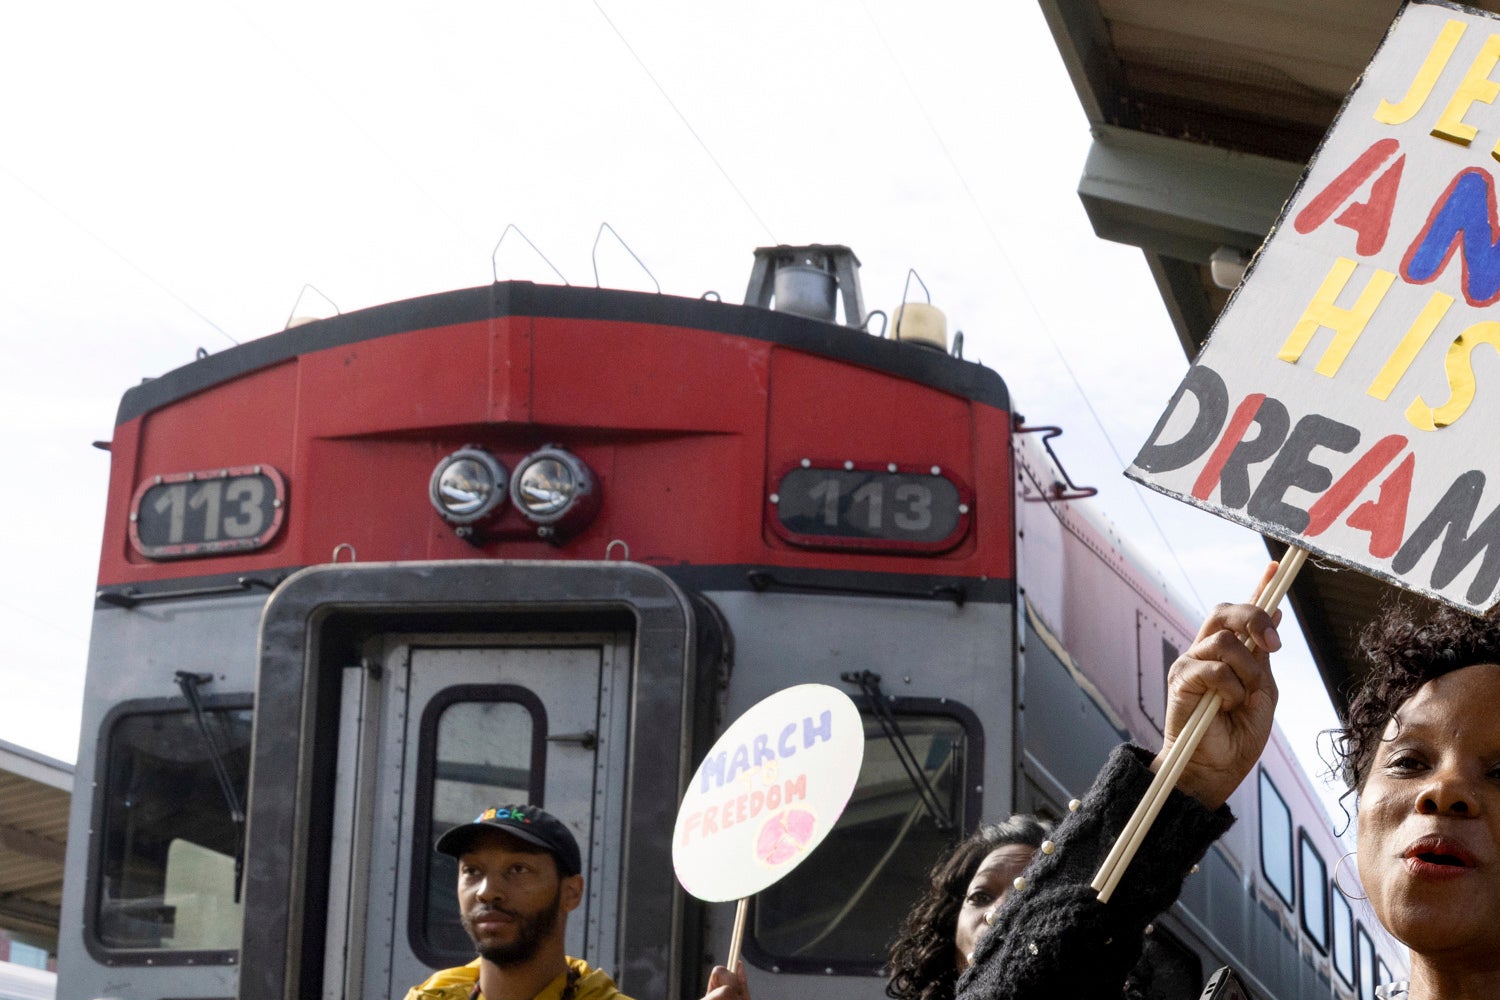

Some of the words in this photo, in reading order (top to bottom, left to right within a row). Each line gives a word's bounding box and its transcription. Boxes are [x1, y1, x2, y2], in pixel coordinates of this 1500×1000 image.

[154, 478, 265, 543] 113
[809, 479, 932, 530] 113
[700, 710, 832, 794] MARCH
[682, 774, 807, 847] FREEDOM
